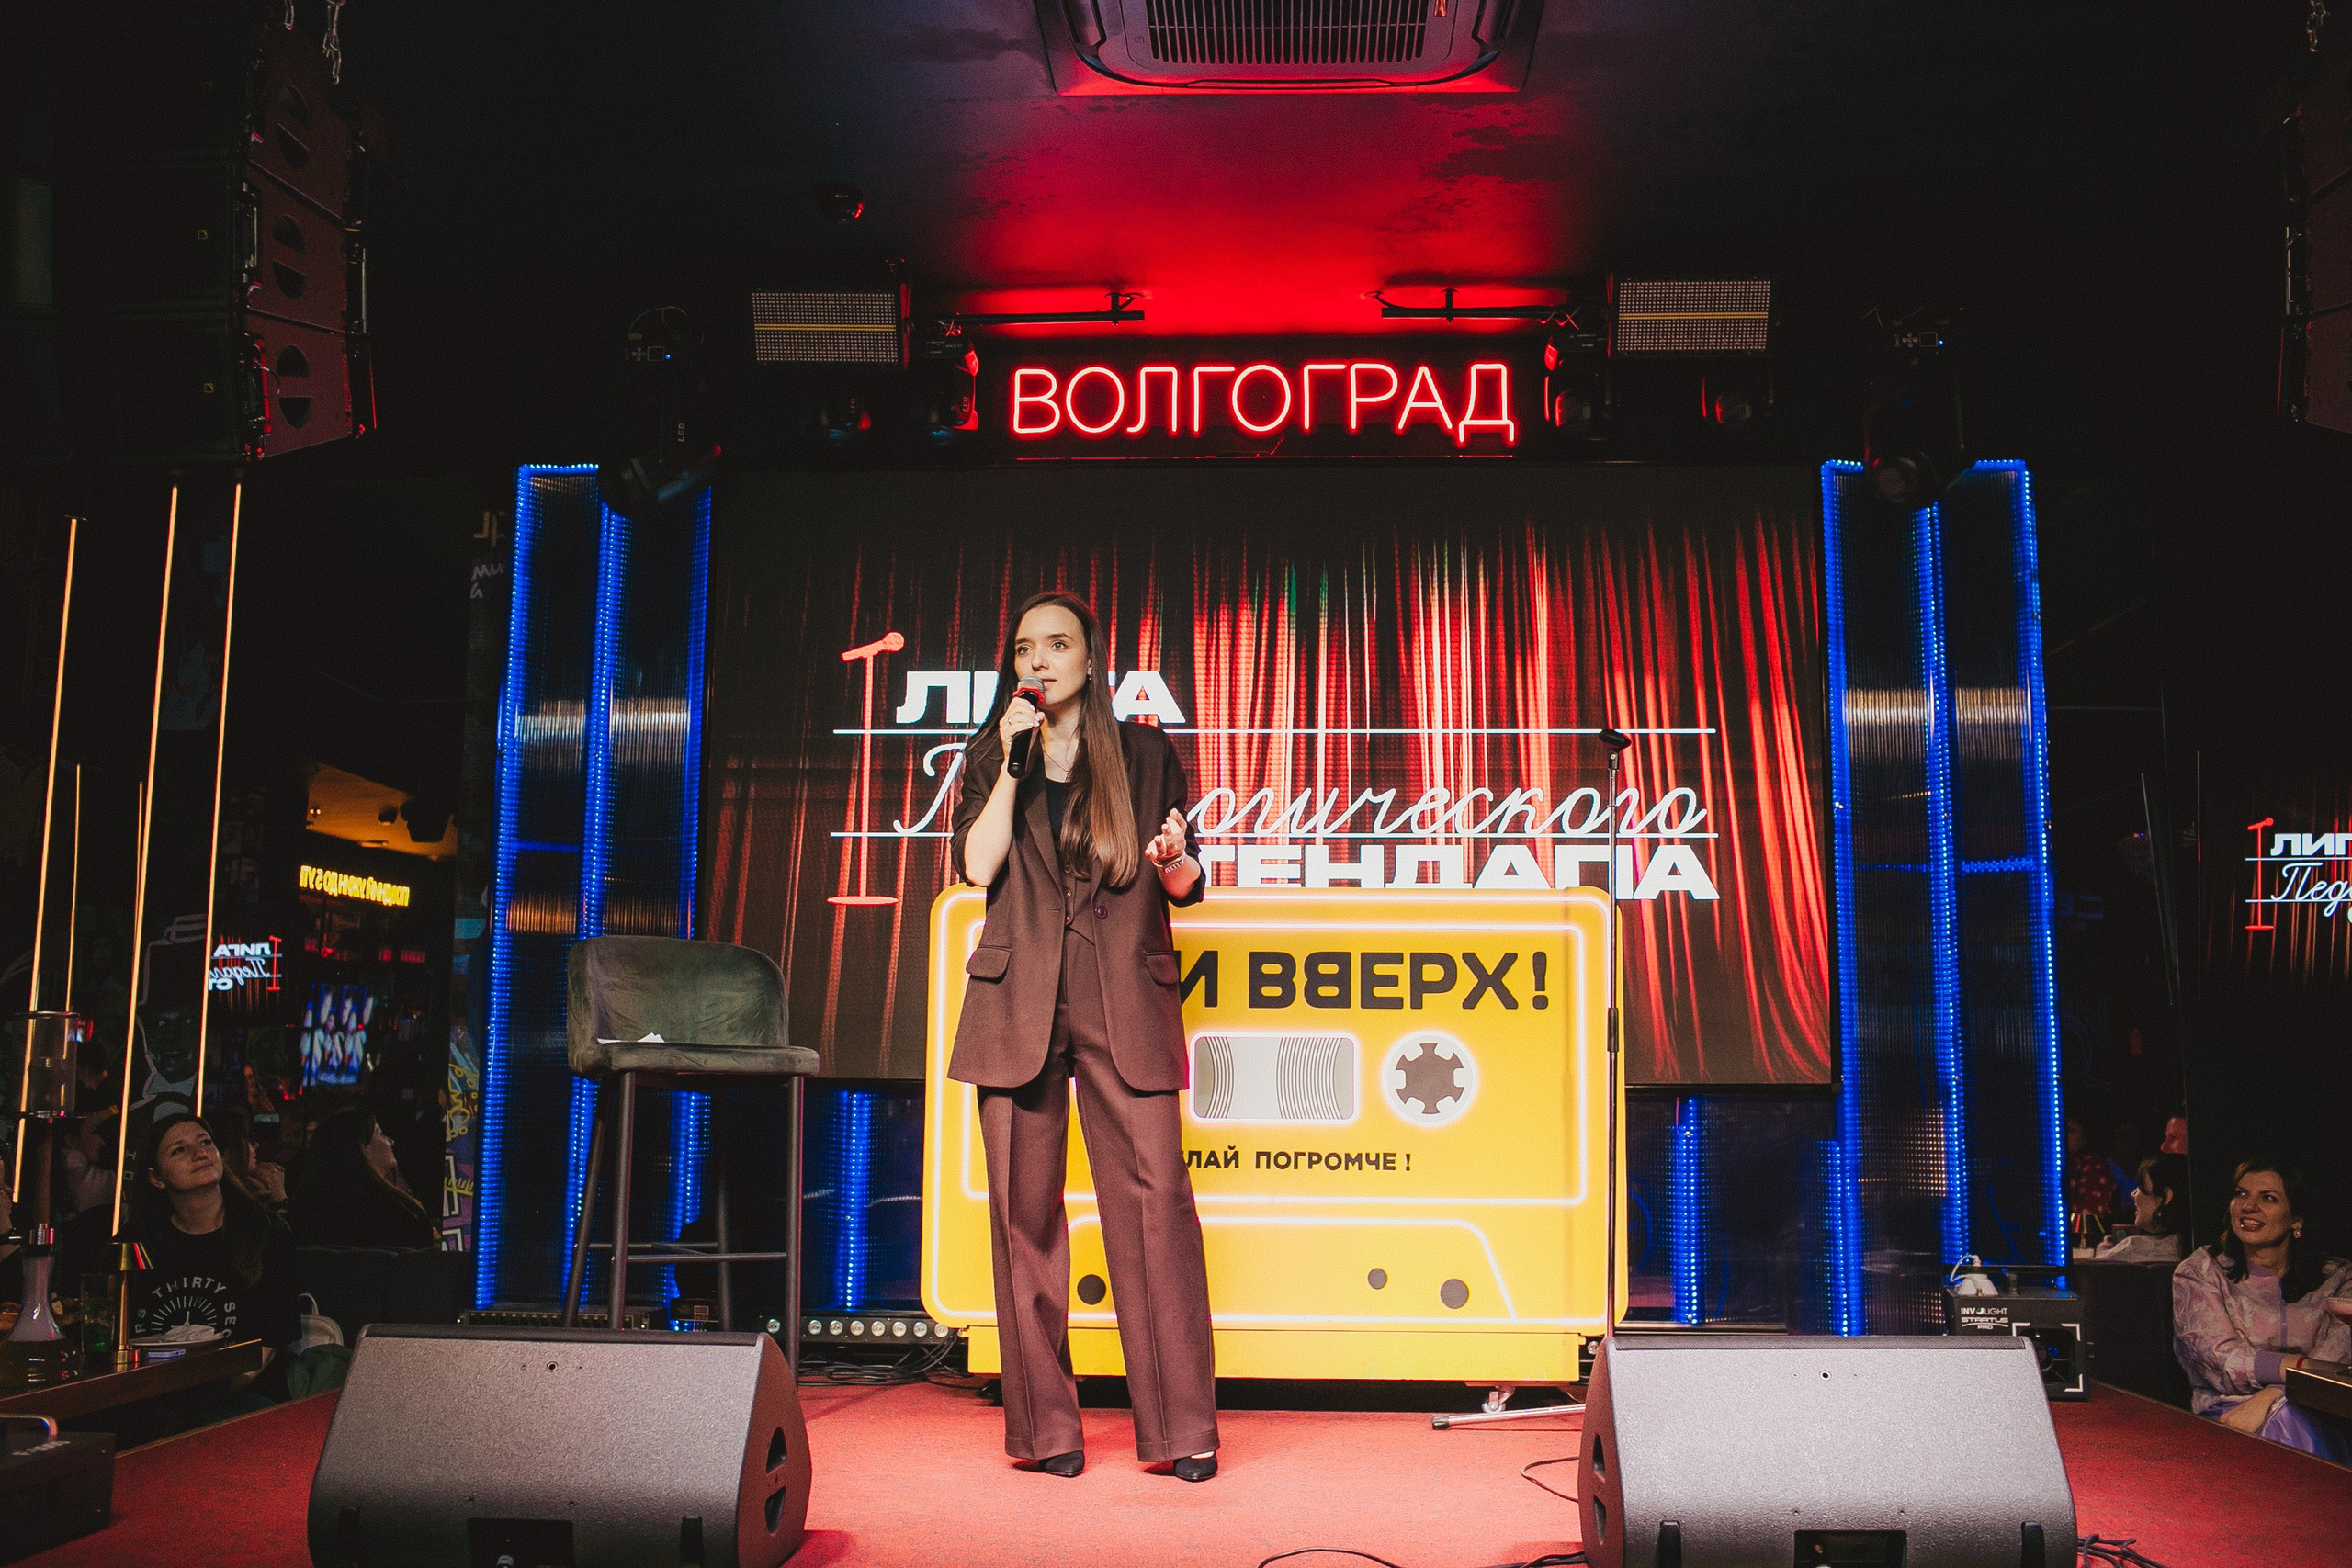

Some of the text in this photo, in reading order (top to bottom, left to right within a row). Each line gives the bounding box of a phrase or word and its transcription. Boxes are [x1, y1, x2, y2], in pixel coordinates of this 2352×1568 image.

[1012, 363, 1515, 443] ВОЛГОГРАД
[896, 670, 1186, 724] ЛА
[152, 1276, 227, 1298] THIRTY
